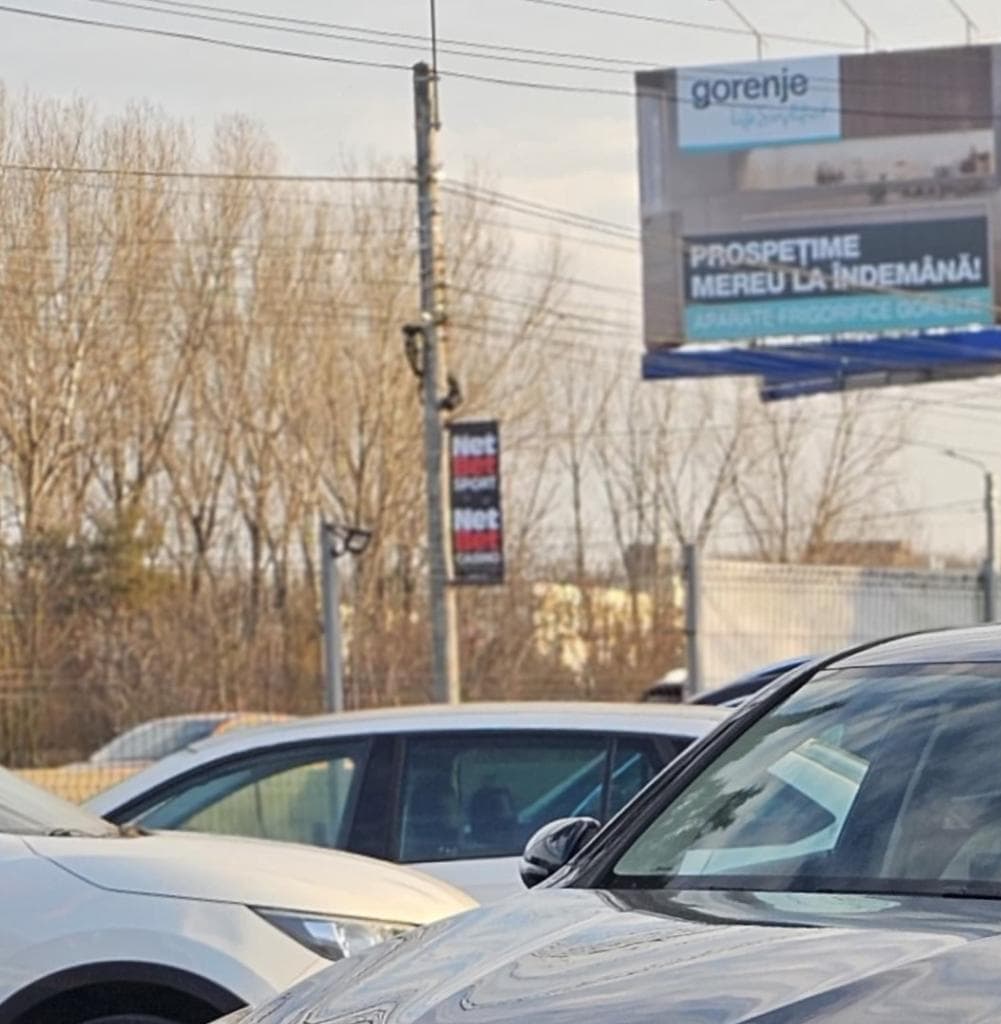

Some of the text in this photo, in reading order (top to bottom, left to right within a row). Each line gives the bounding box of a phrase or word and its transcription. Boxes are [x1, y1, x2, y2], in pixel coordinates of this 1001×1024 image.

[692, 67, 809, 110] gorenje
[691, 271, 786, 299] MEREU
[794, 268, 821, 293] LA
[454, 508, 500, 531] Net
